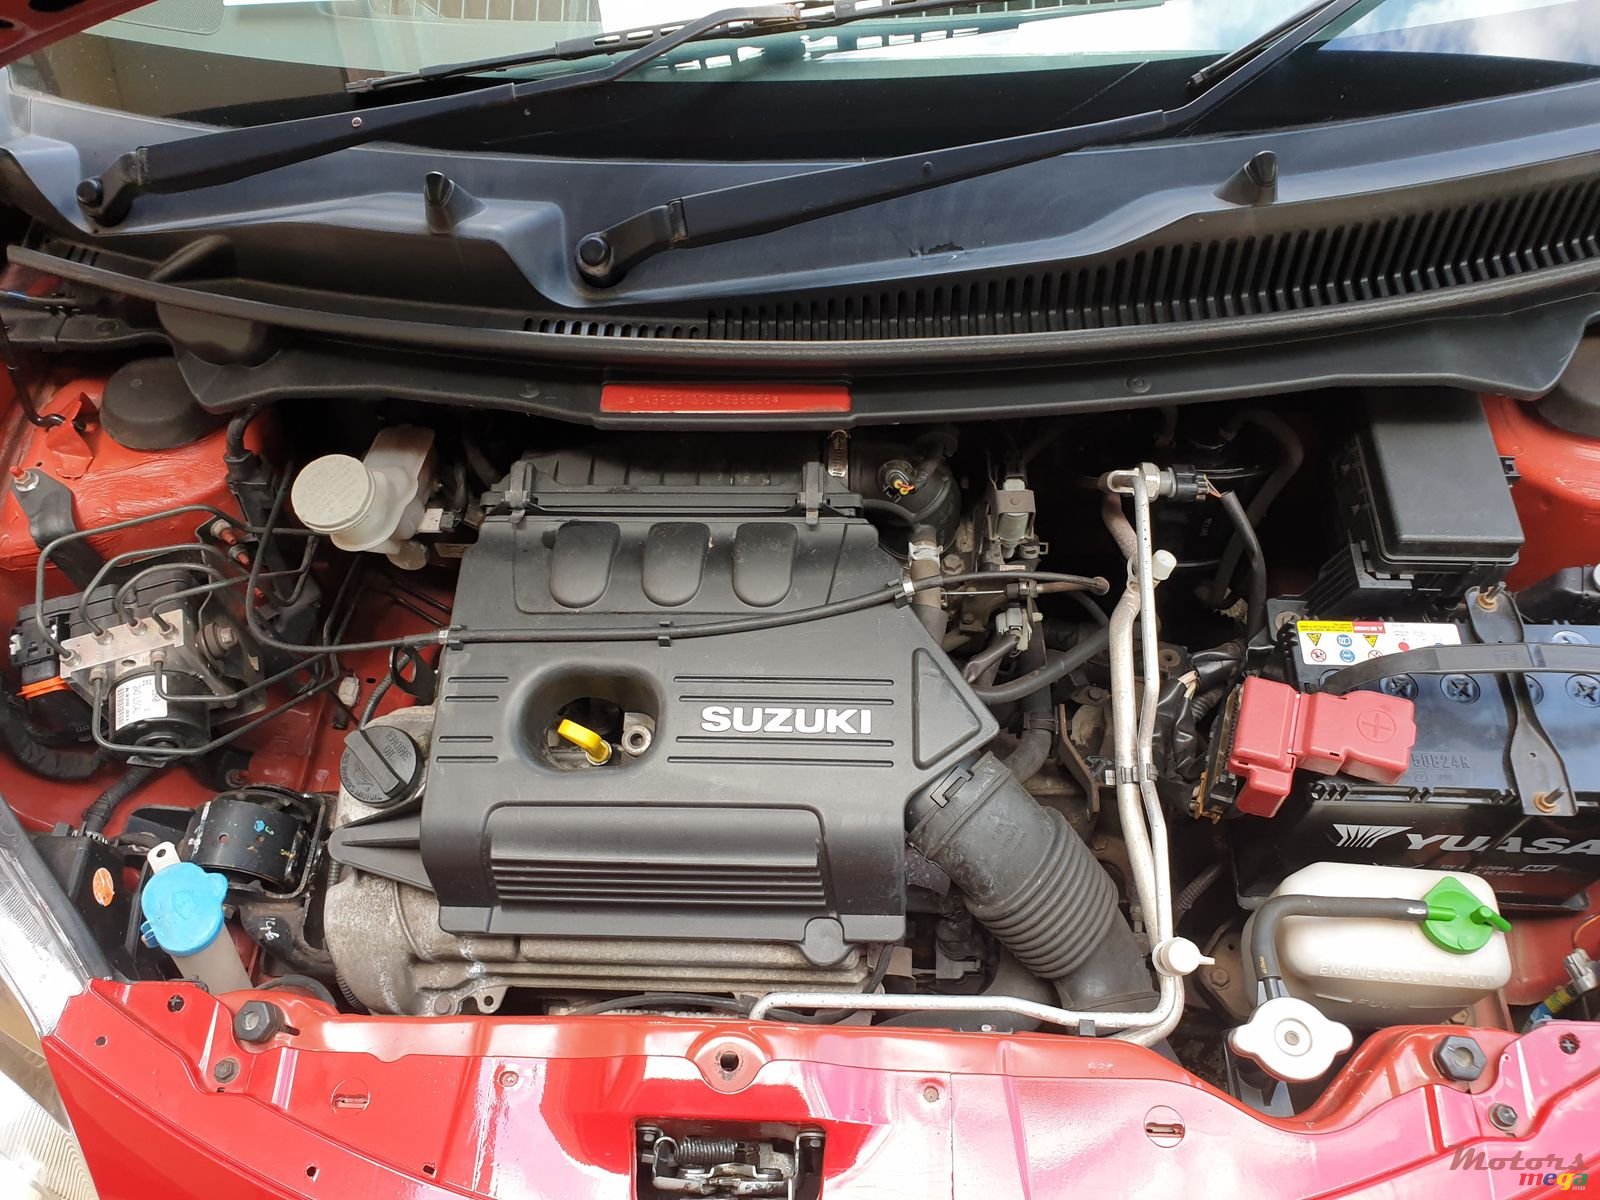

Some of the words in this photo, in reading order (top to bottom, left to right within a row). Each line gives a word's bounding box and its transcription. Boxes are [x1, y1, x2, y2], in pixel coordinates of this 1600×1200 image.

[701, 705, 872, 735] SUZUKI
[386, 730, 412, 761] ENGINE
[1405, 833, 1600, 855] YUASA
[1319, 962, 1376, 979] ENGINE
[1379, 968, 1454, 984] COOLANT
[1457, 974, 1498, 988] ONLY
